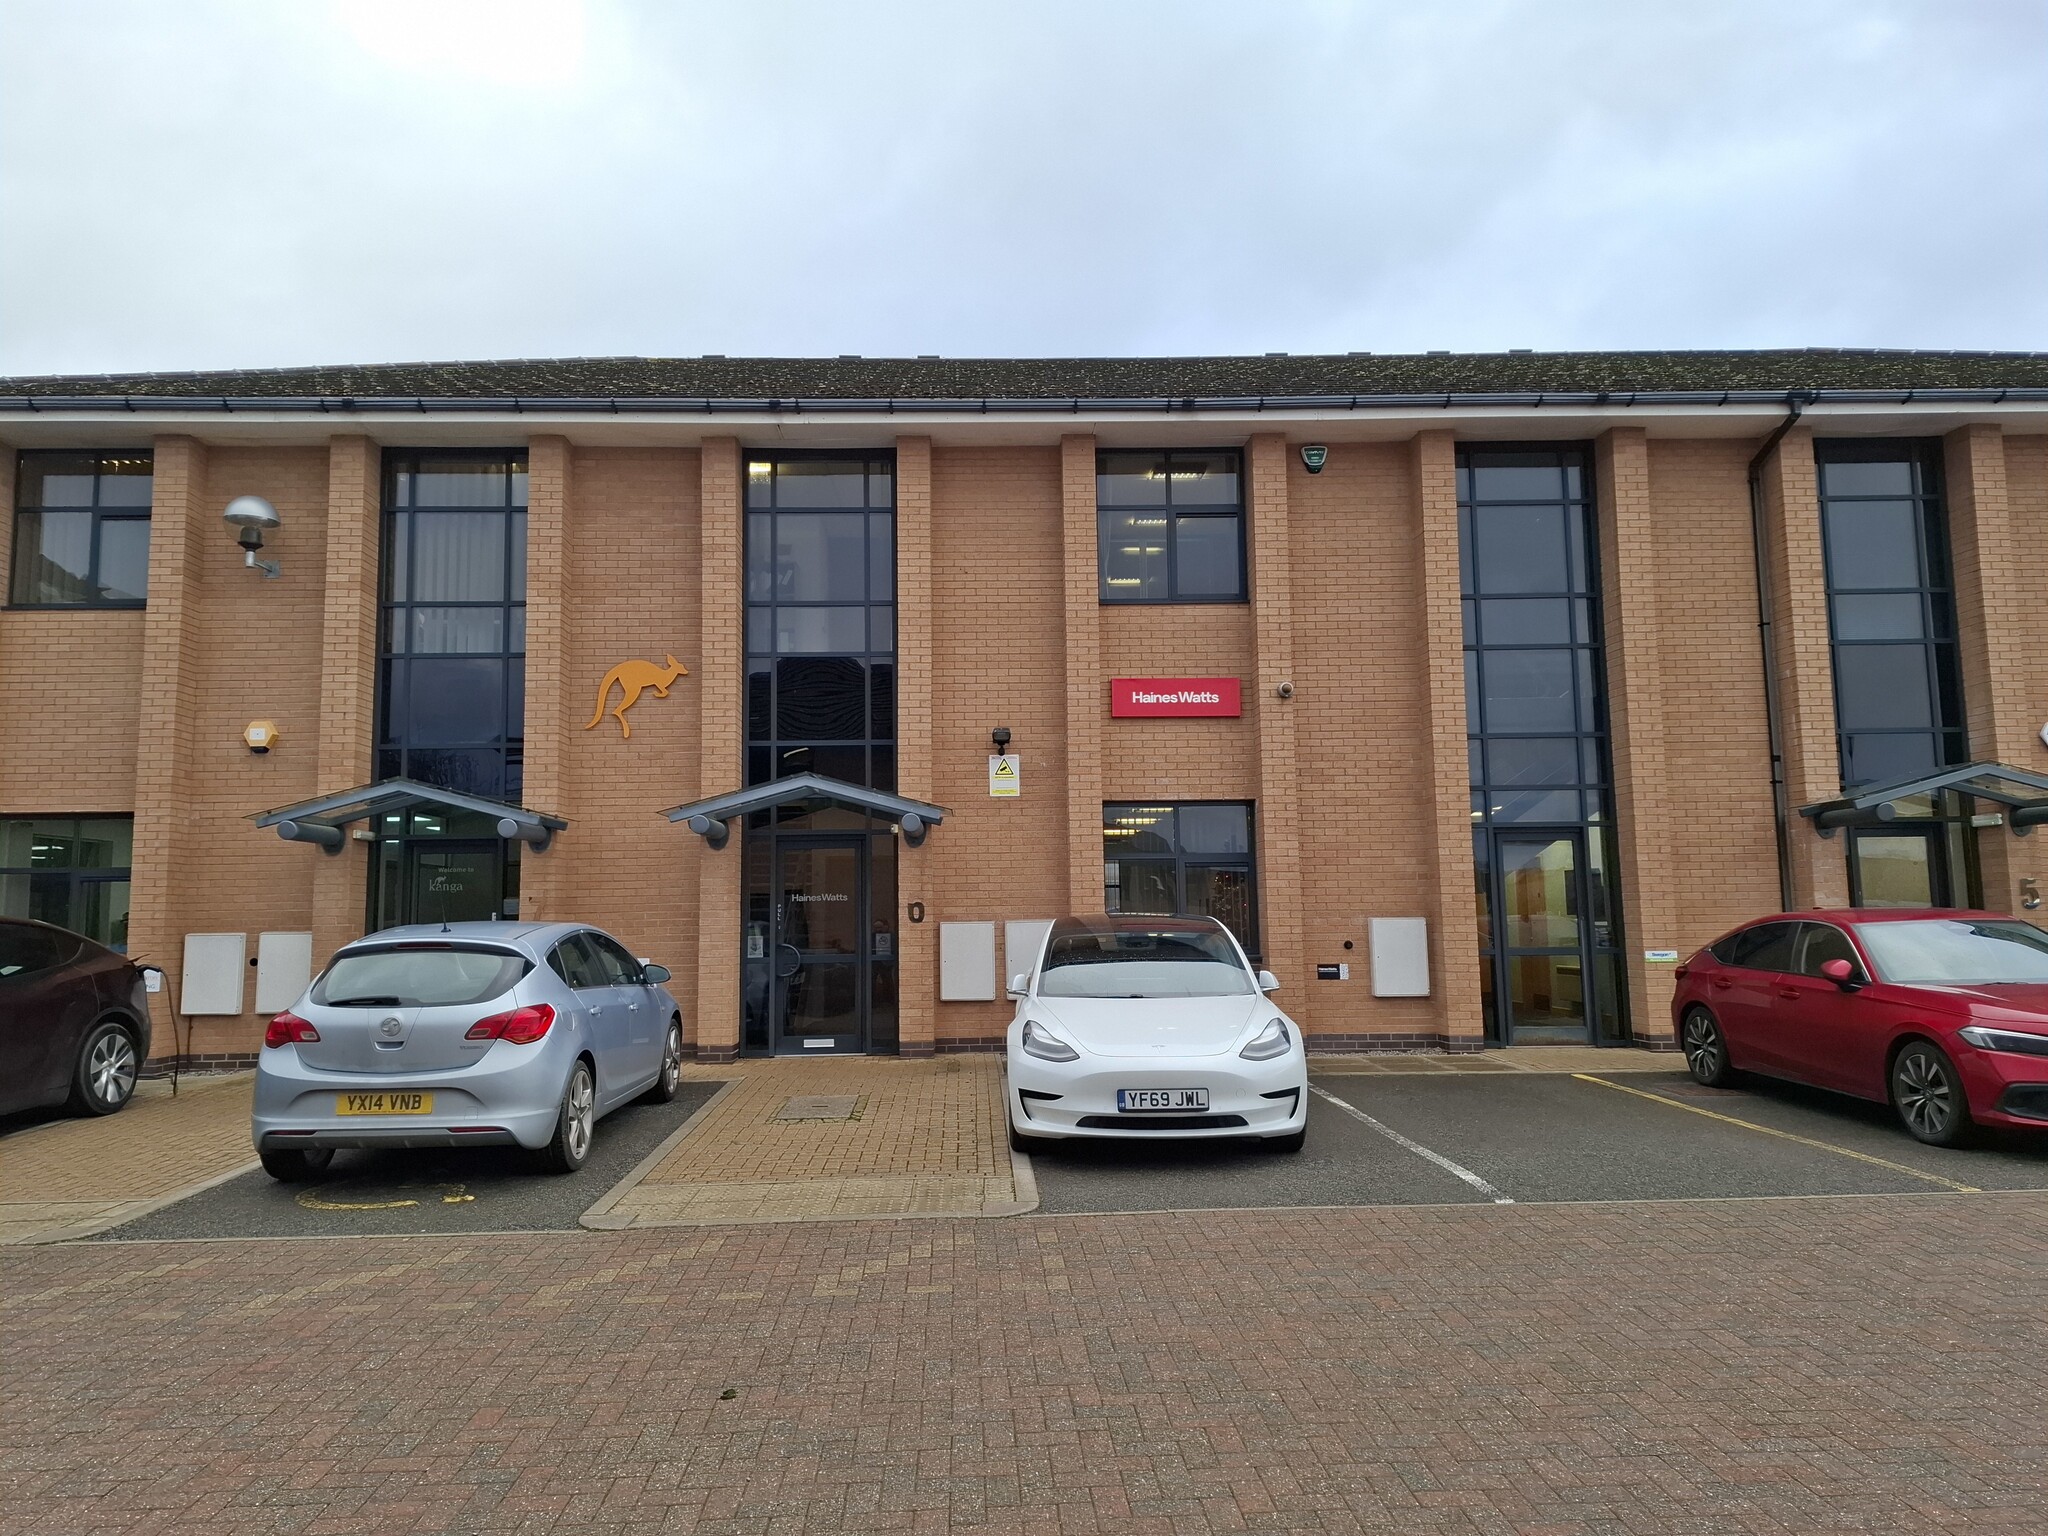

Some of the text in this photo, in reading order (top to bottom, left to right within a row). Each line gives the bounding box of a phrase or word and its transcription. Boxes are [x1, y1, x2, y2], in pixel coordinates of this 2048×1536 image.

[1132, 691, 1219, 703] Haines Watts
[428, 879, 464, 894] kanga
[2019, 878, 2041, 910] 5
[791, 893, 848, 902] Haines Watts
[347, 1094, 422, 1111] YX14 VNB
[1128, 1091, 1206, 1107] YF69 JWL
